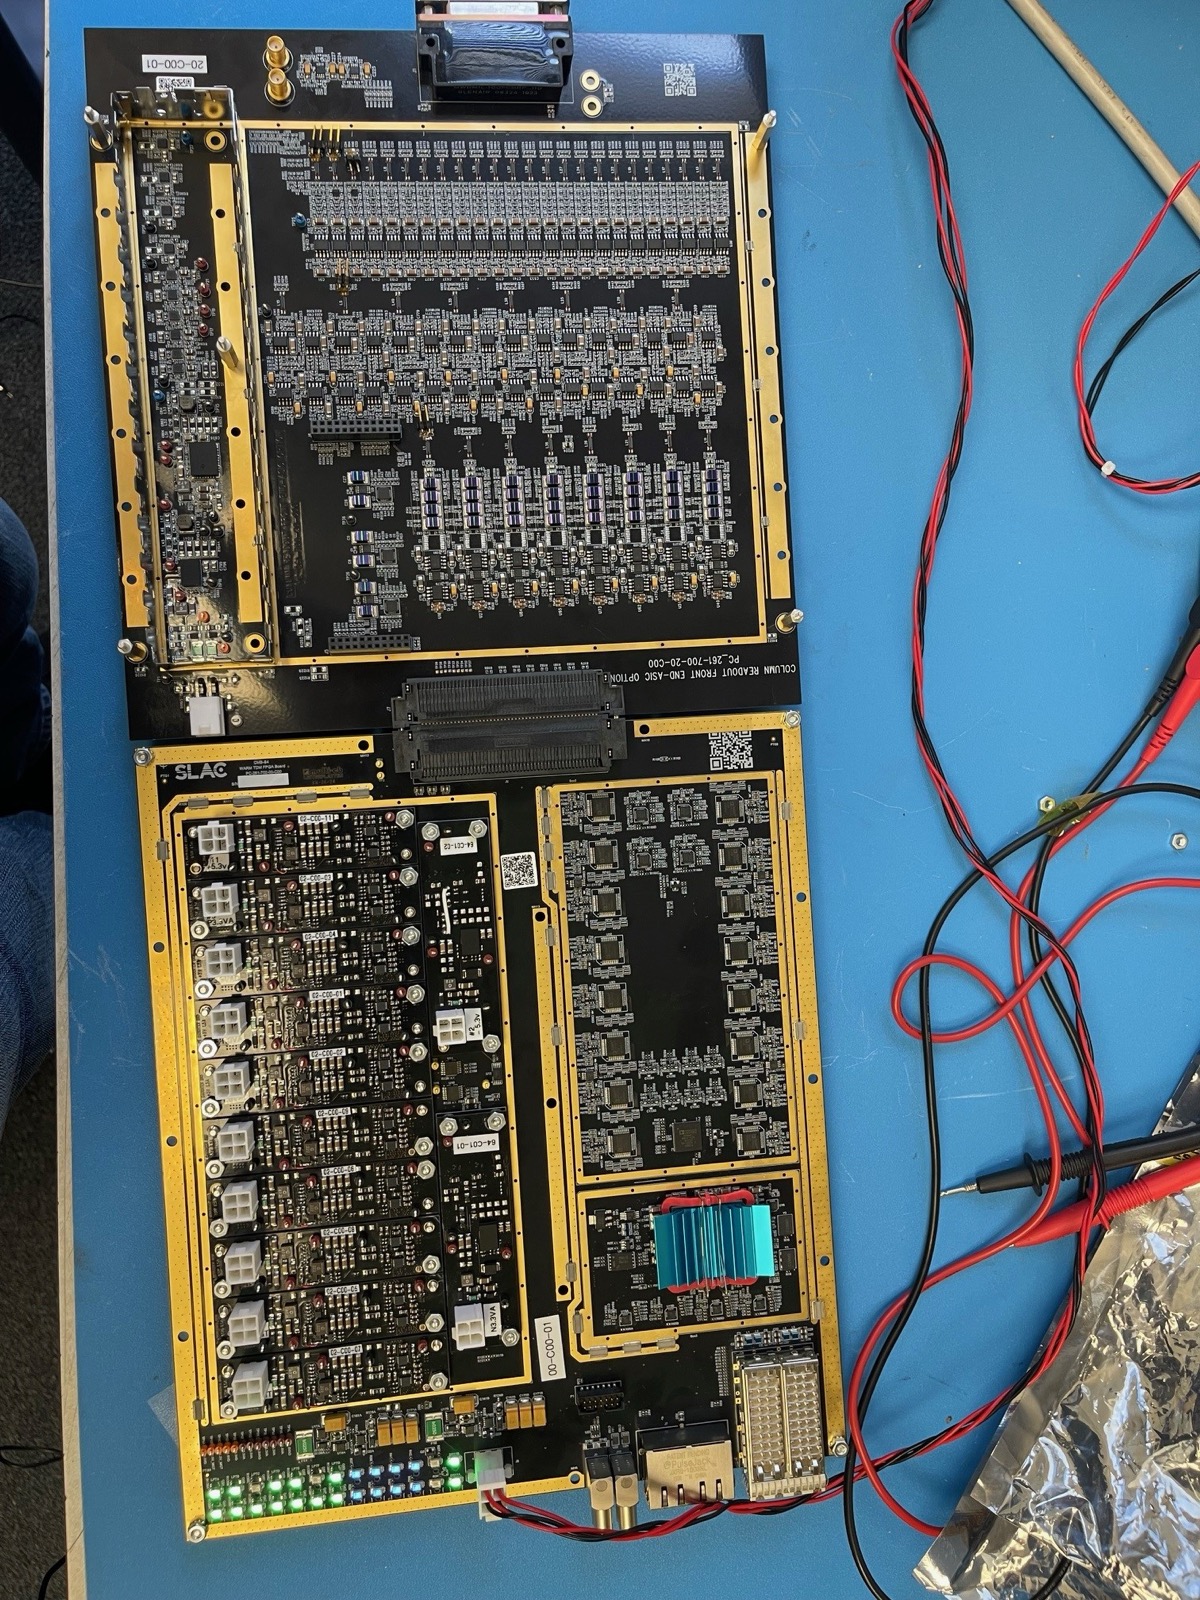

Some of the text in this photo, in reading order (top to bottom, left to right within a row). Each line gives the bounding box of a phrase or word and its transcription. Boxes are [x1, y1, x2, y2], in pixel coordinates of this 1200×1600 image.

[147, 59, 204, 70] 20-C00-01
[648, 654, 740, 668] PC_261-700-20-C00
[610, 664, 796, 682] COLUMN READOUT FRONT END-ASIC OPTION
[174, 762, 228, 780] SLAC
[456, 1139, 496, 1150] 64-C01-01
[489, 1306, 497, 1332] N3.3VA
[543, 1322, 557, 1376] 00-C00-01
